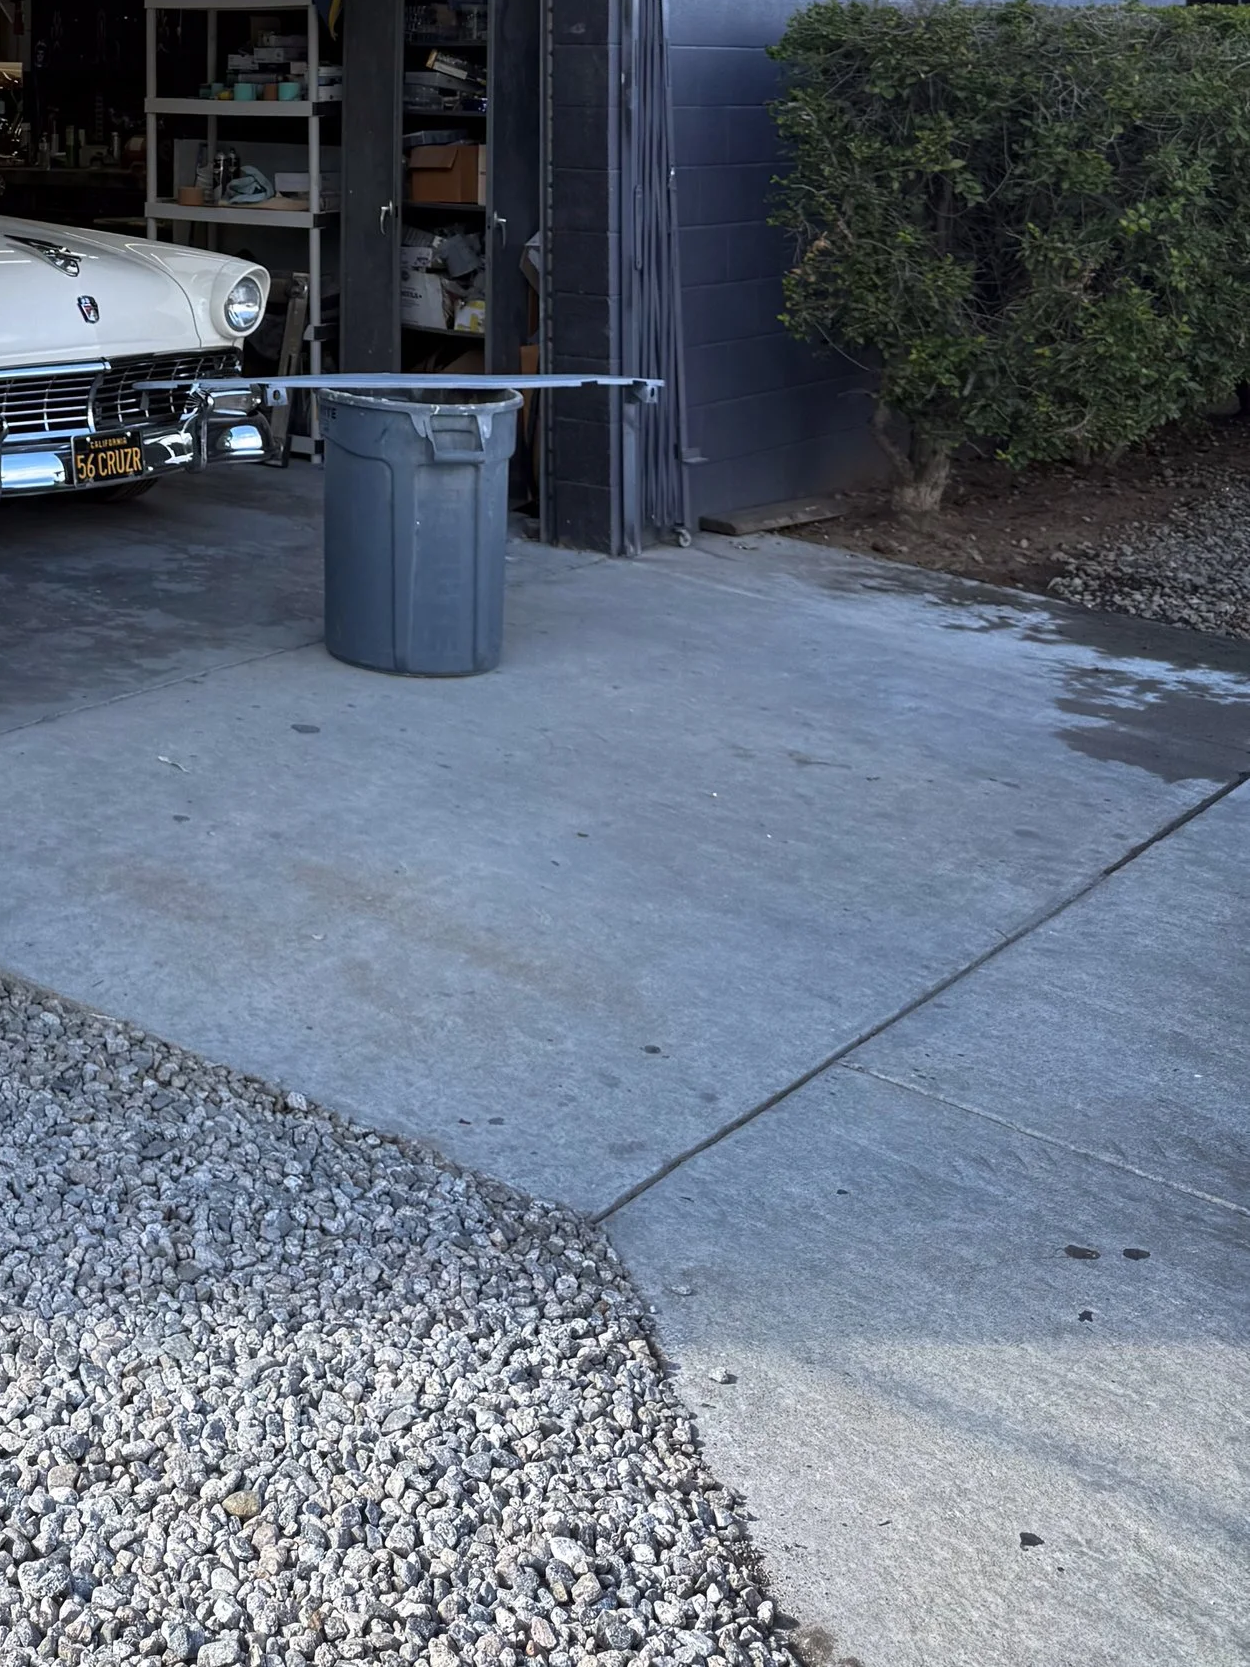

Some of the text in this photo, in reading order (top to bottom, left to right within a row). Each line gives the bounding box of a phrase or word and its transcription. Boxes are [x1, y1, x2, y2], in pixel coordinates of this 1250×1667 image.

[90, 437, 127, 449] CALIFORNIA
[77, 447, 142, 479] 56 CRUZR
